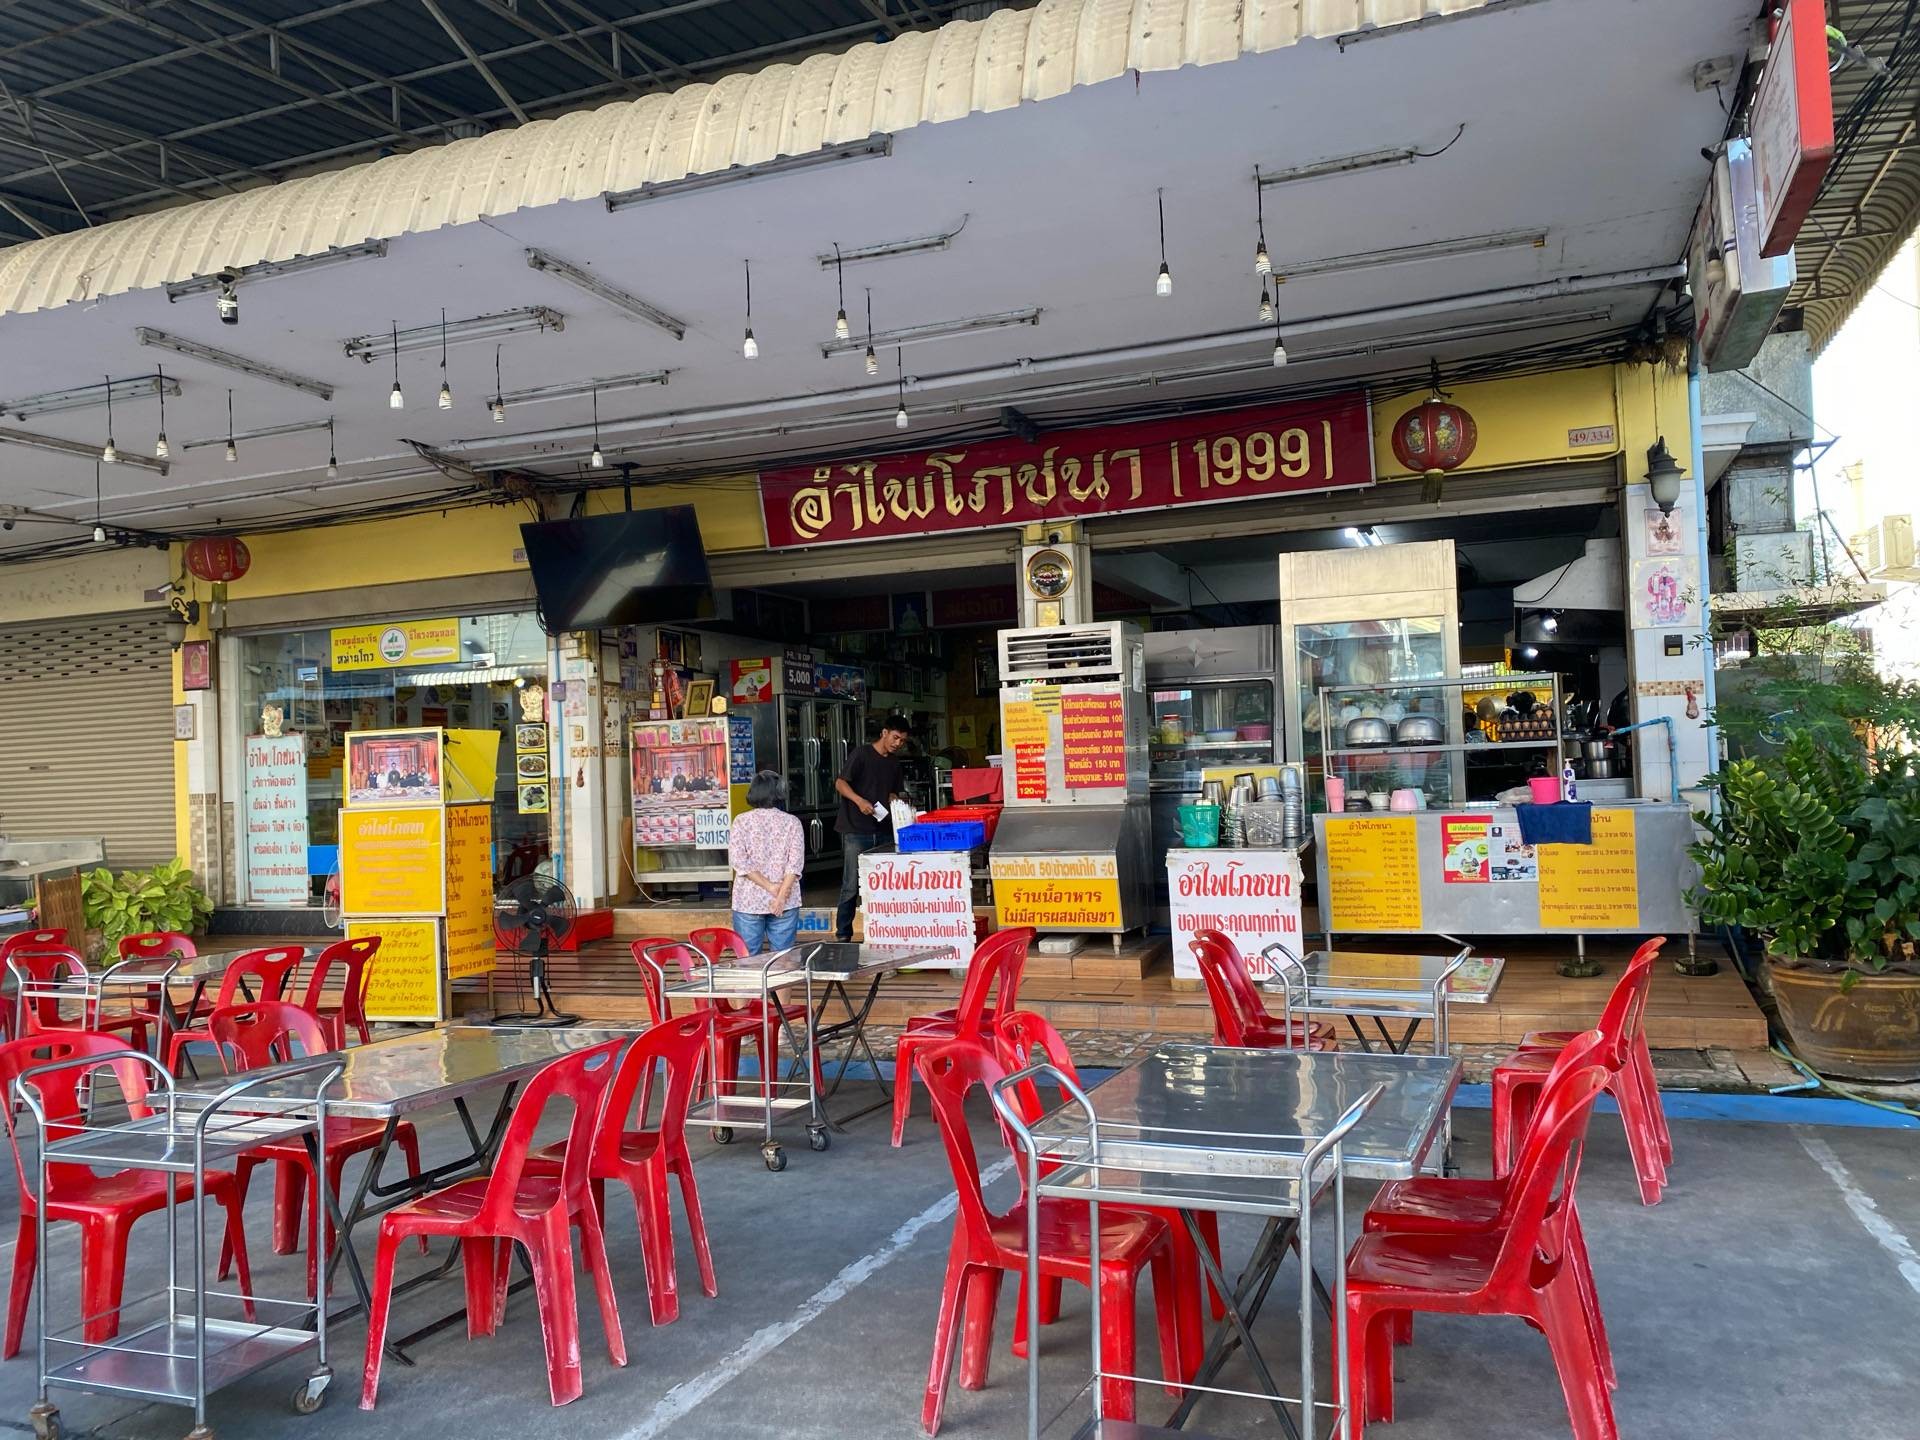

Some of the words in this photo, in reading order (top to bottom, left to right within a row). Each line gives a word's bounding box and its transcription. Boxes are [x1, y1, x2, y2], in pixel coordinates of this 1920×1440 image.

[791, 446, 1141, 538] อำไพโภชนา
[867, 860, 962, 890] อำไพโภชนา
[1178, 861, 1291, 896] อำไพโภชนา
[1013, 883, 1102, 903] ร้านนี้อาหาร
[1004, 907, 1115, 923] ไม่มีสารผสมกัญชา
[1178, 908, 1297, 937] ขอบพระคุณทุกท่าน
